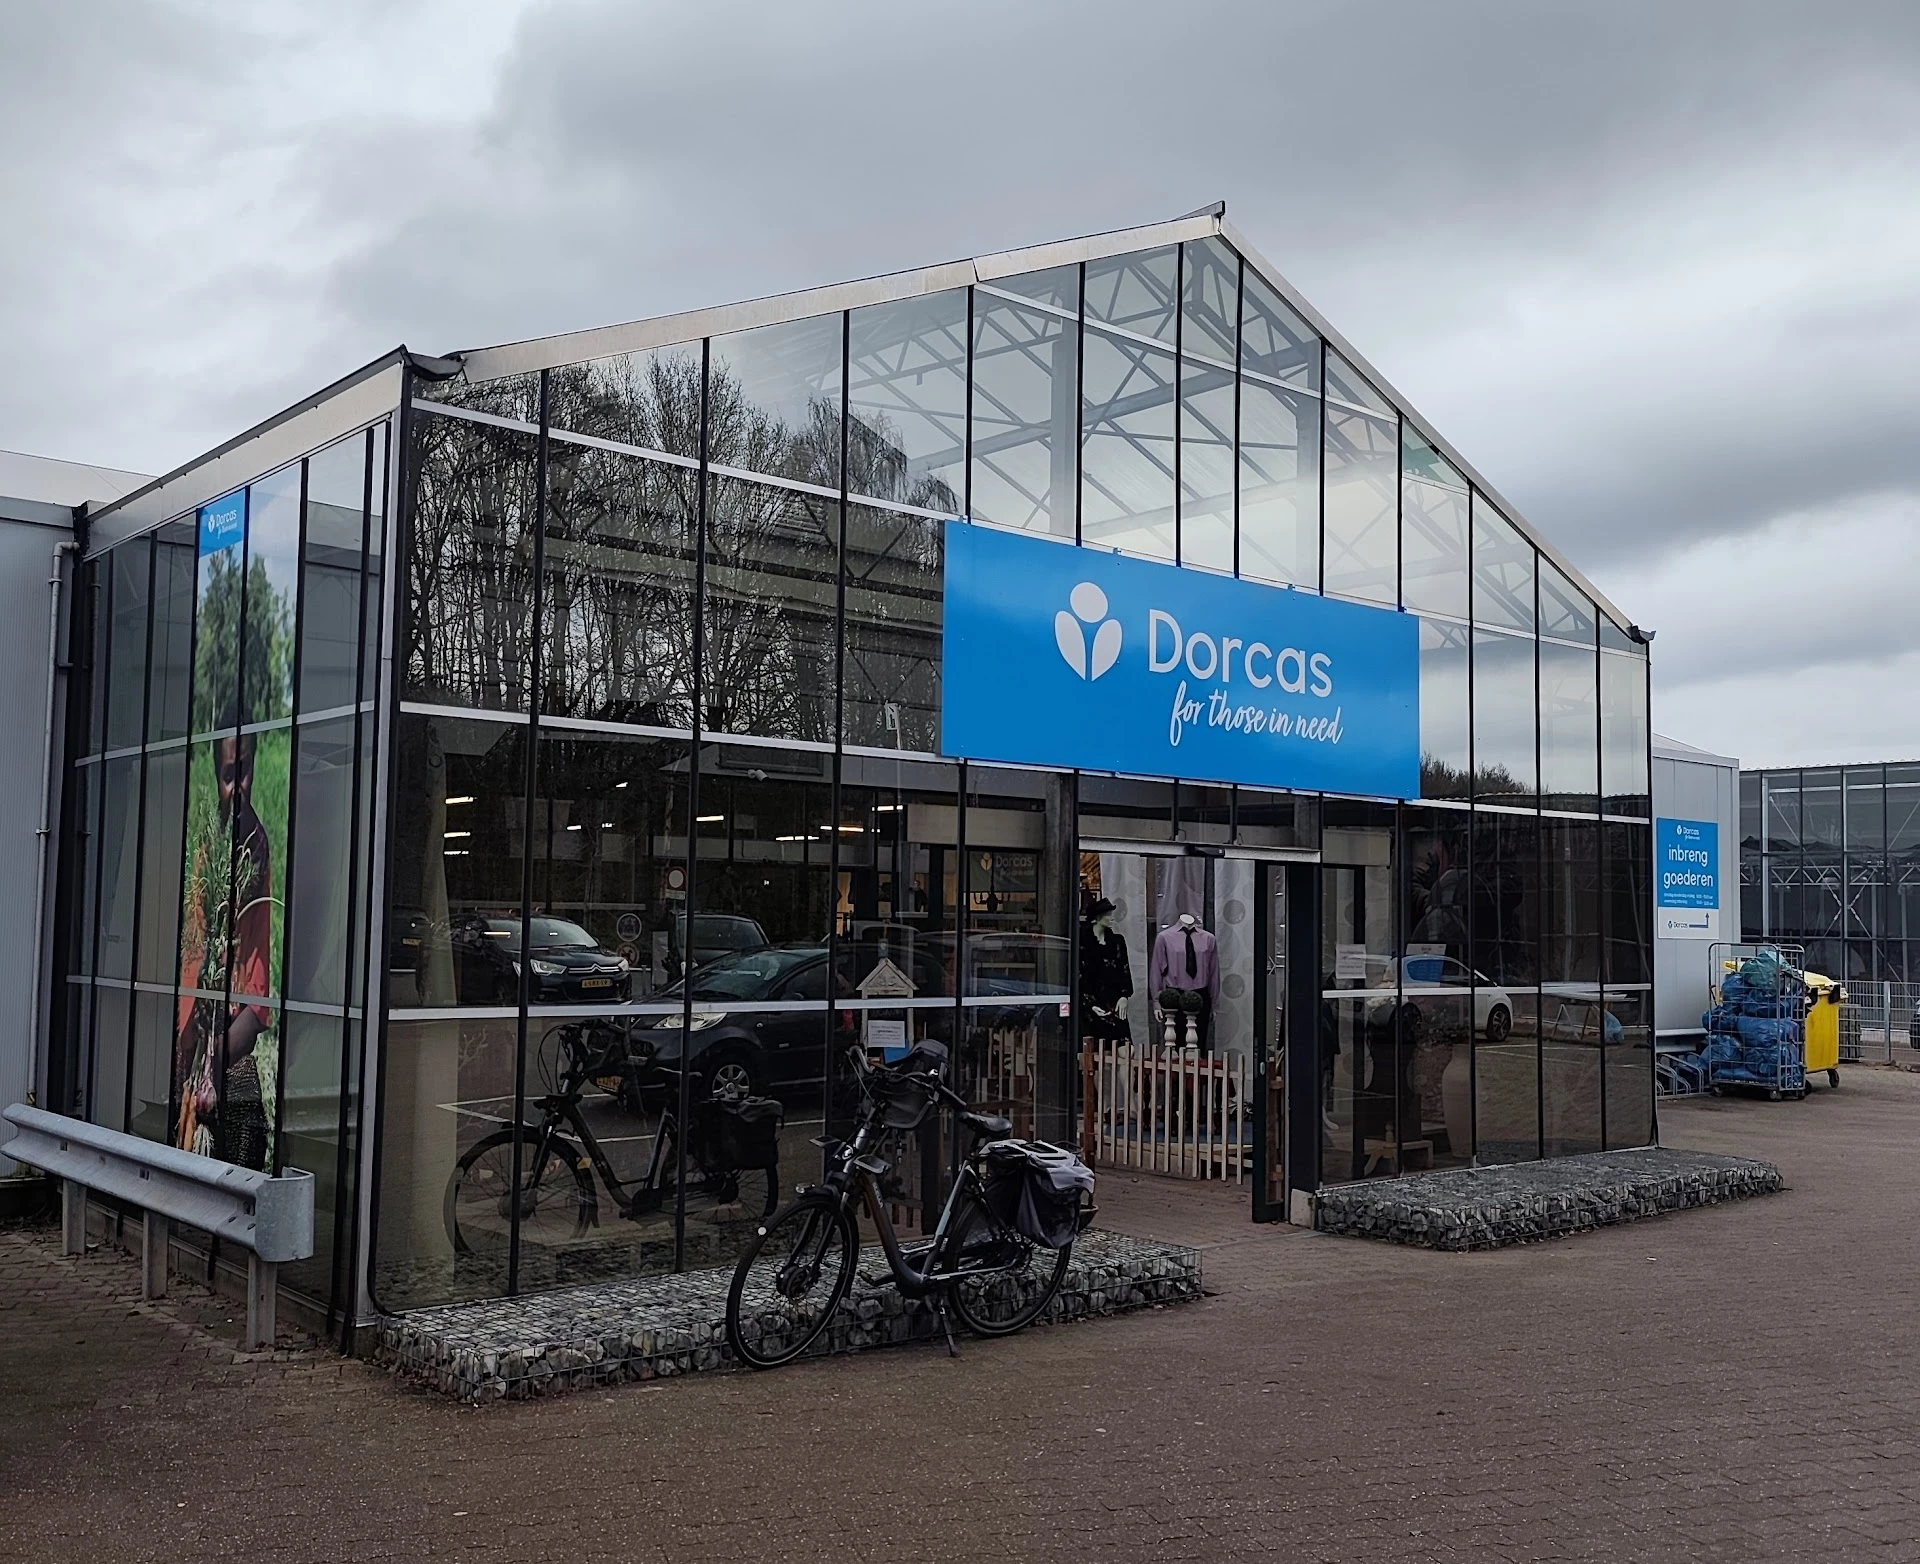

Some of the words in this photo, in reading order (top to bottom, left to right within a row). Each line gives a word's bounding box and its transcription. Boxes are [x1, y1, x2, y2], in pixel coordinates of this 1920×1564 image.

[216, 509, 237, 527] Dorcas
[1149, 608, 1333, 698] Dorcas
[1170, 680, 1206, 747] for
[1208, 688, 1268, 734] those
[1269, 707, 1294, 737] in
[1295, 706, 1344, 745] need
[1683, 827, 1699, 835] Dorcas
[996, 856, 1033, 867] Dorcas
[1668, 844, 1708, 867] inbreng
[1663, 869, 1714, 889] goederen
